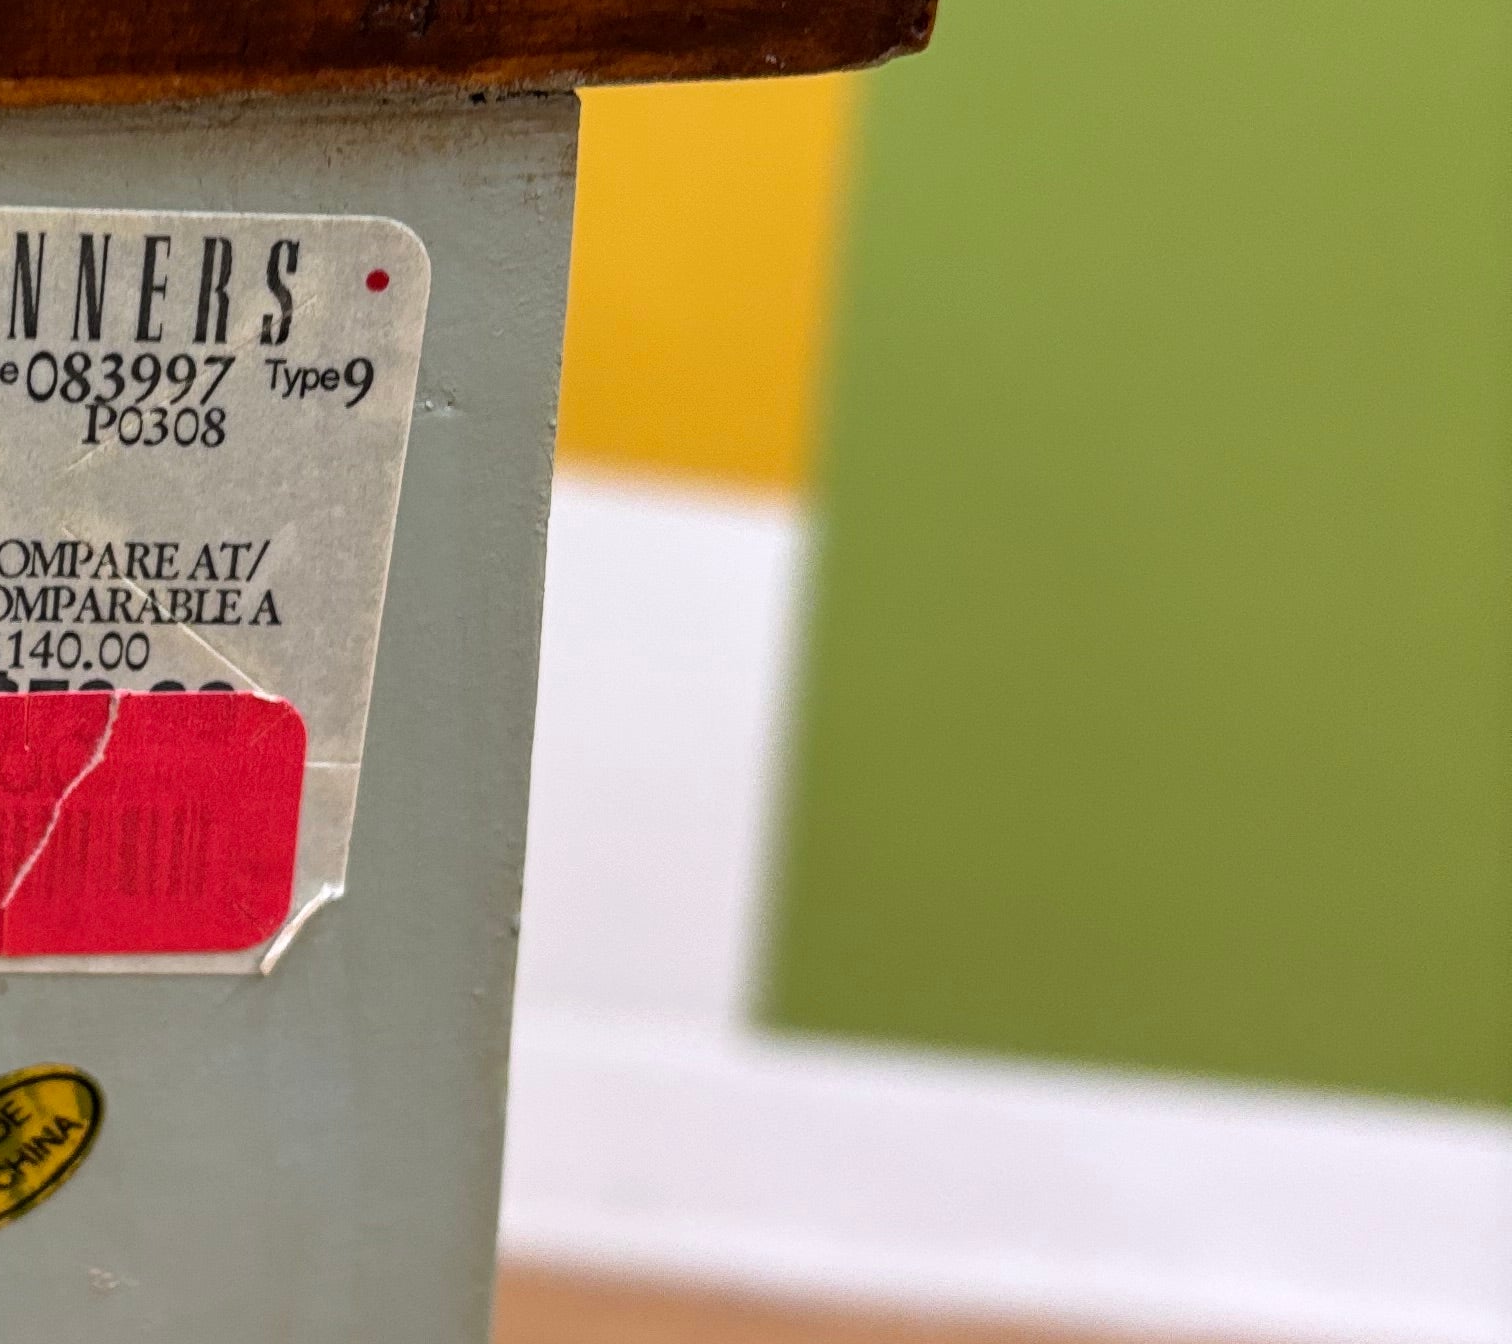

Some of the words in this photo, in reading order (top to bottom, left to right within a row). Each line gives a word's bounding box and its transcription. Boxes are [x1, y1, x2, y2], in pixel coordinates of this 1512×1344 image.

[26, 350, 237, 406] 083997
[263, 358, 340, 398] Type
[343, 357, 375, 408] 9
[81, 401, 227, 447] P0308
[188, 538, 272, 583] AT/
[248, 588, 283, 626] A
